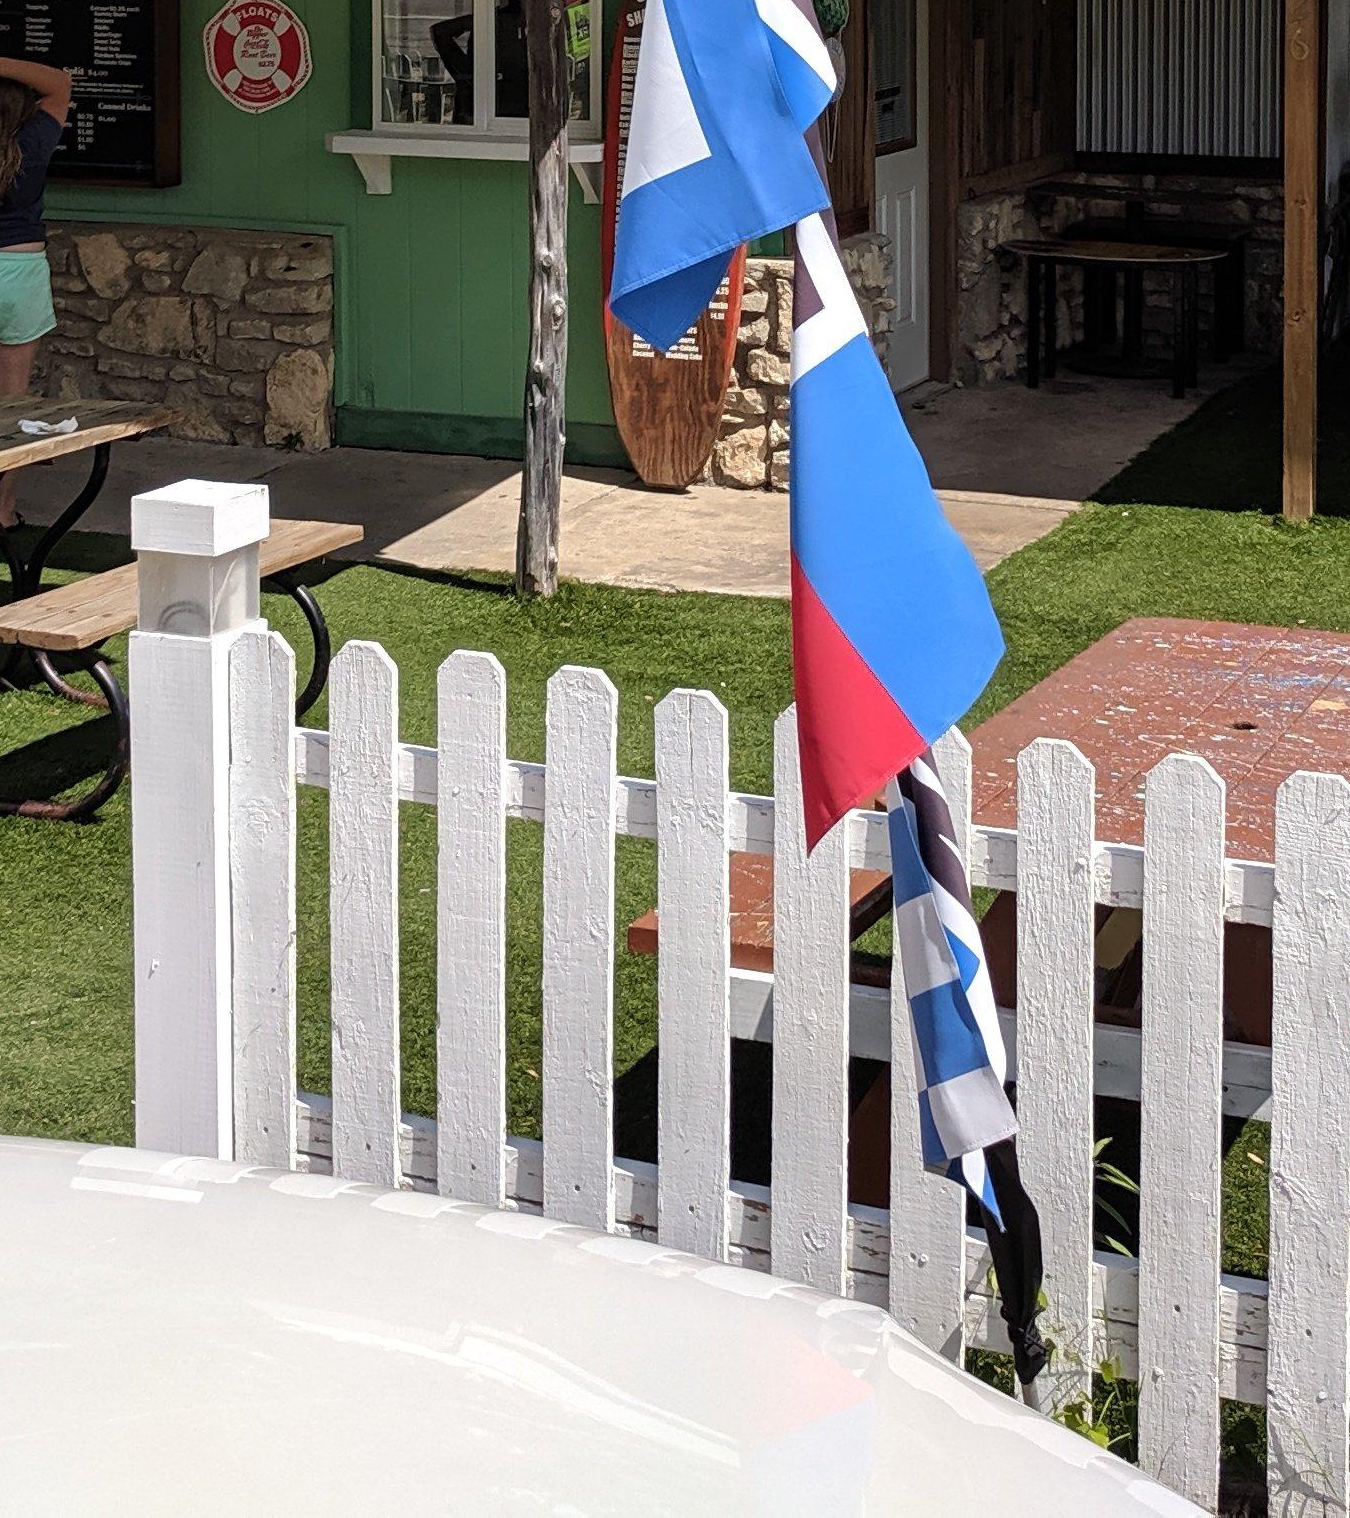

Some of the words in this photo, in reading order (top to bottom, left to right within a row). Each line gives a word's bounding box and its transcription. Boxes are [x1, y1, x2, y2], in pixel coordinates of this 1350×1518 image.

[235, 6, 279, 22] FLOATS
[98, 102, 126, 111] Canned
[126, 103, 152, 112] Drinks
